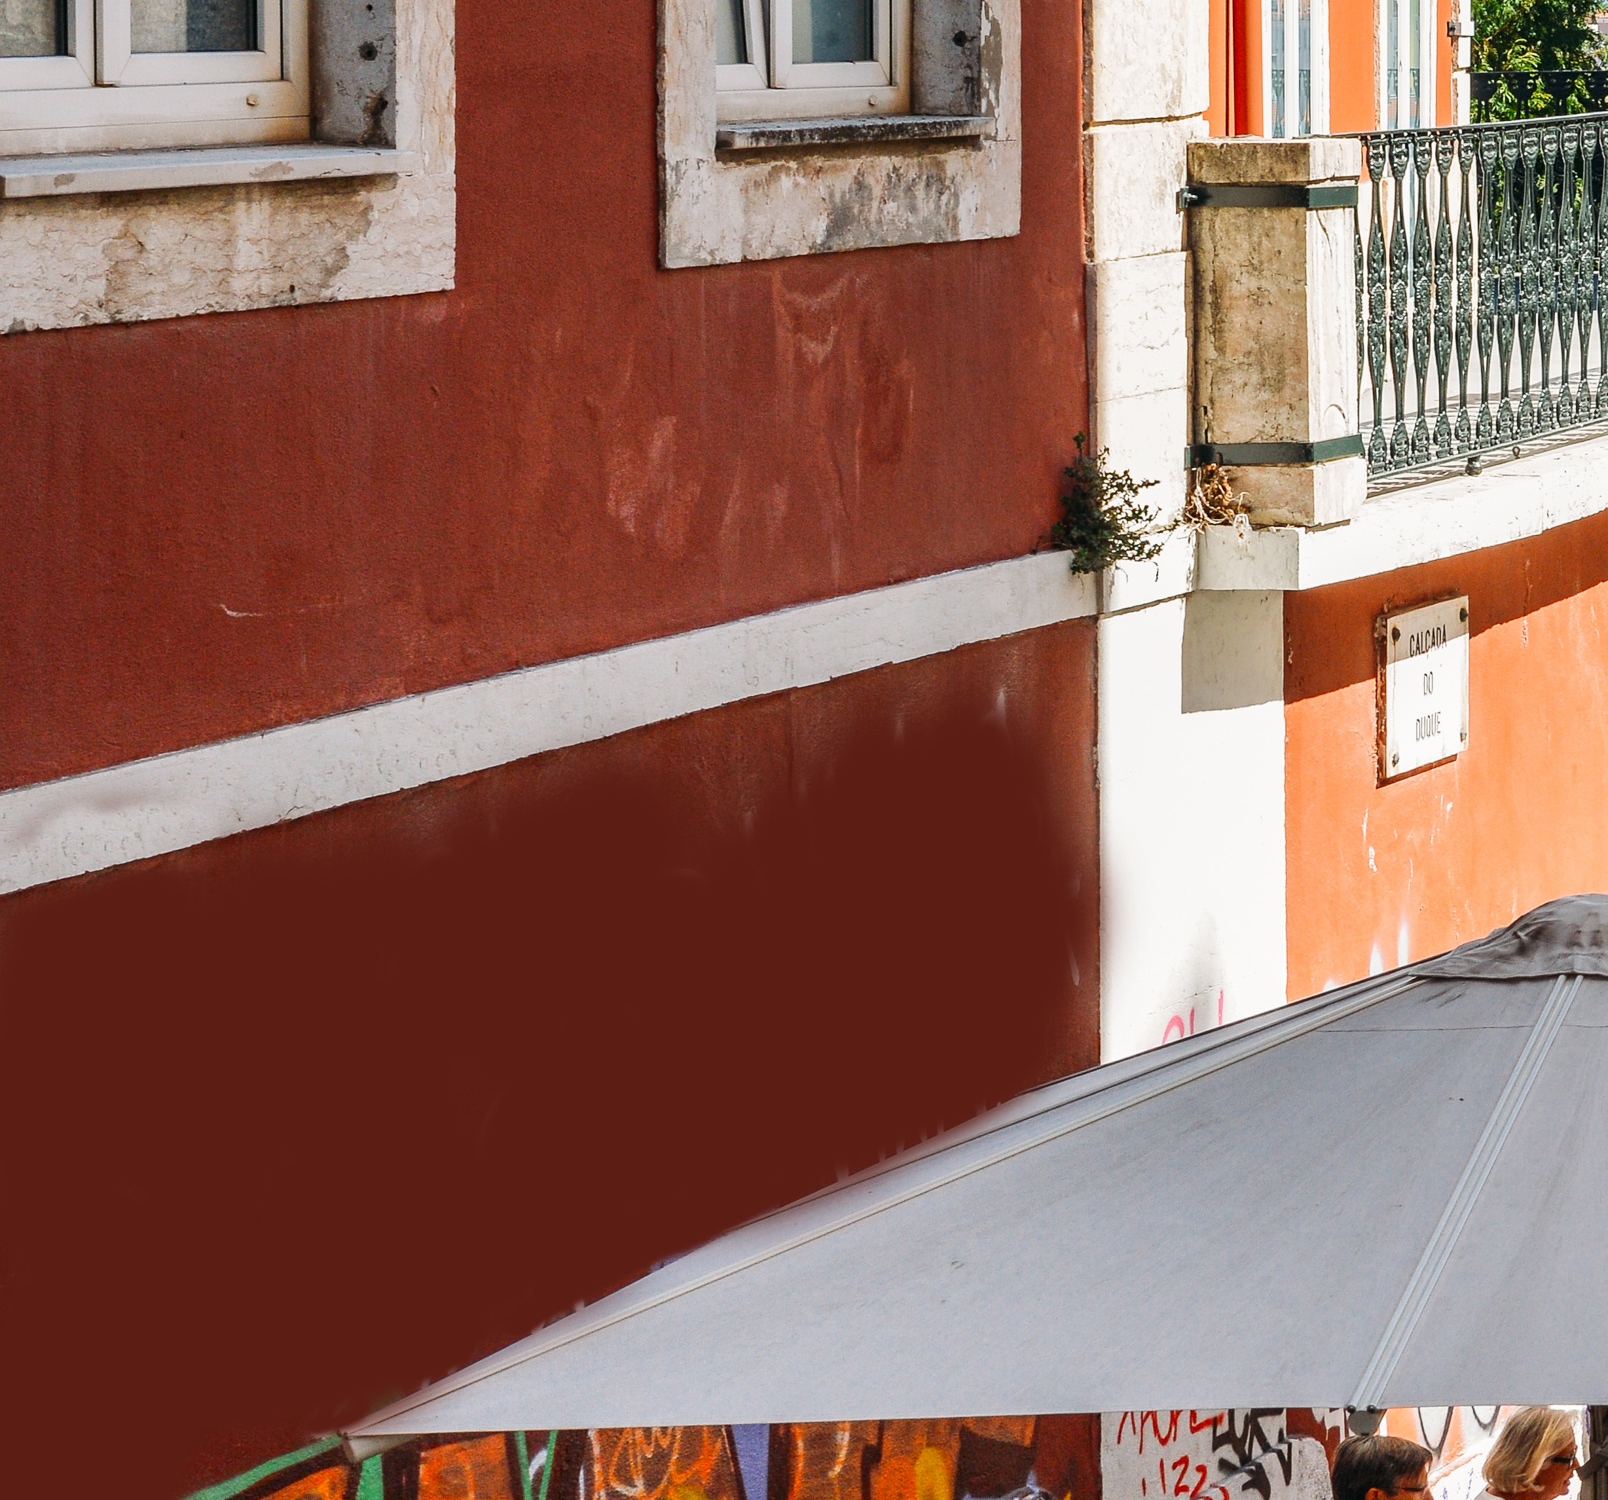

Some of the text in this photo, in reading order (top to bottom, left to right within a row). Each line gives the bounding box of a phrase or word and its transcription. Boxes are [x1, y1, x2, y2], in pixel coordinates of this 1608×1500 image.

[1409, 624, 1447, 658] CALÇADA
[1423, 671, 1434, 695] DO
[1415, 711, 1441, 742] DUQUE
